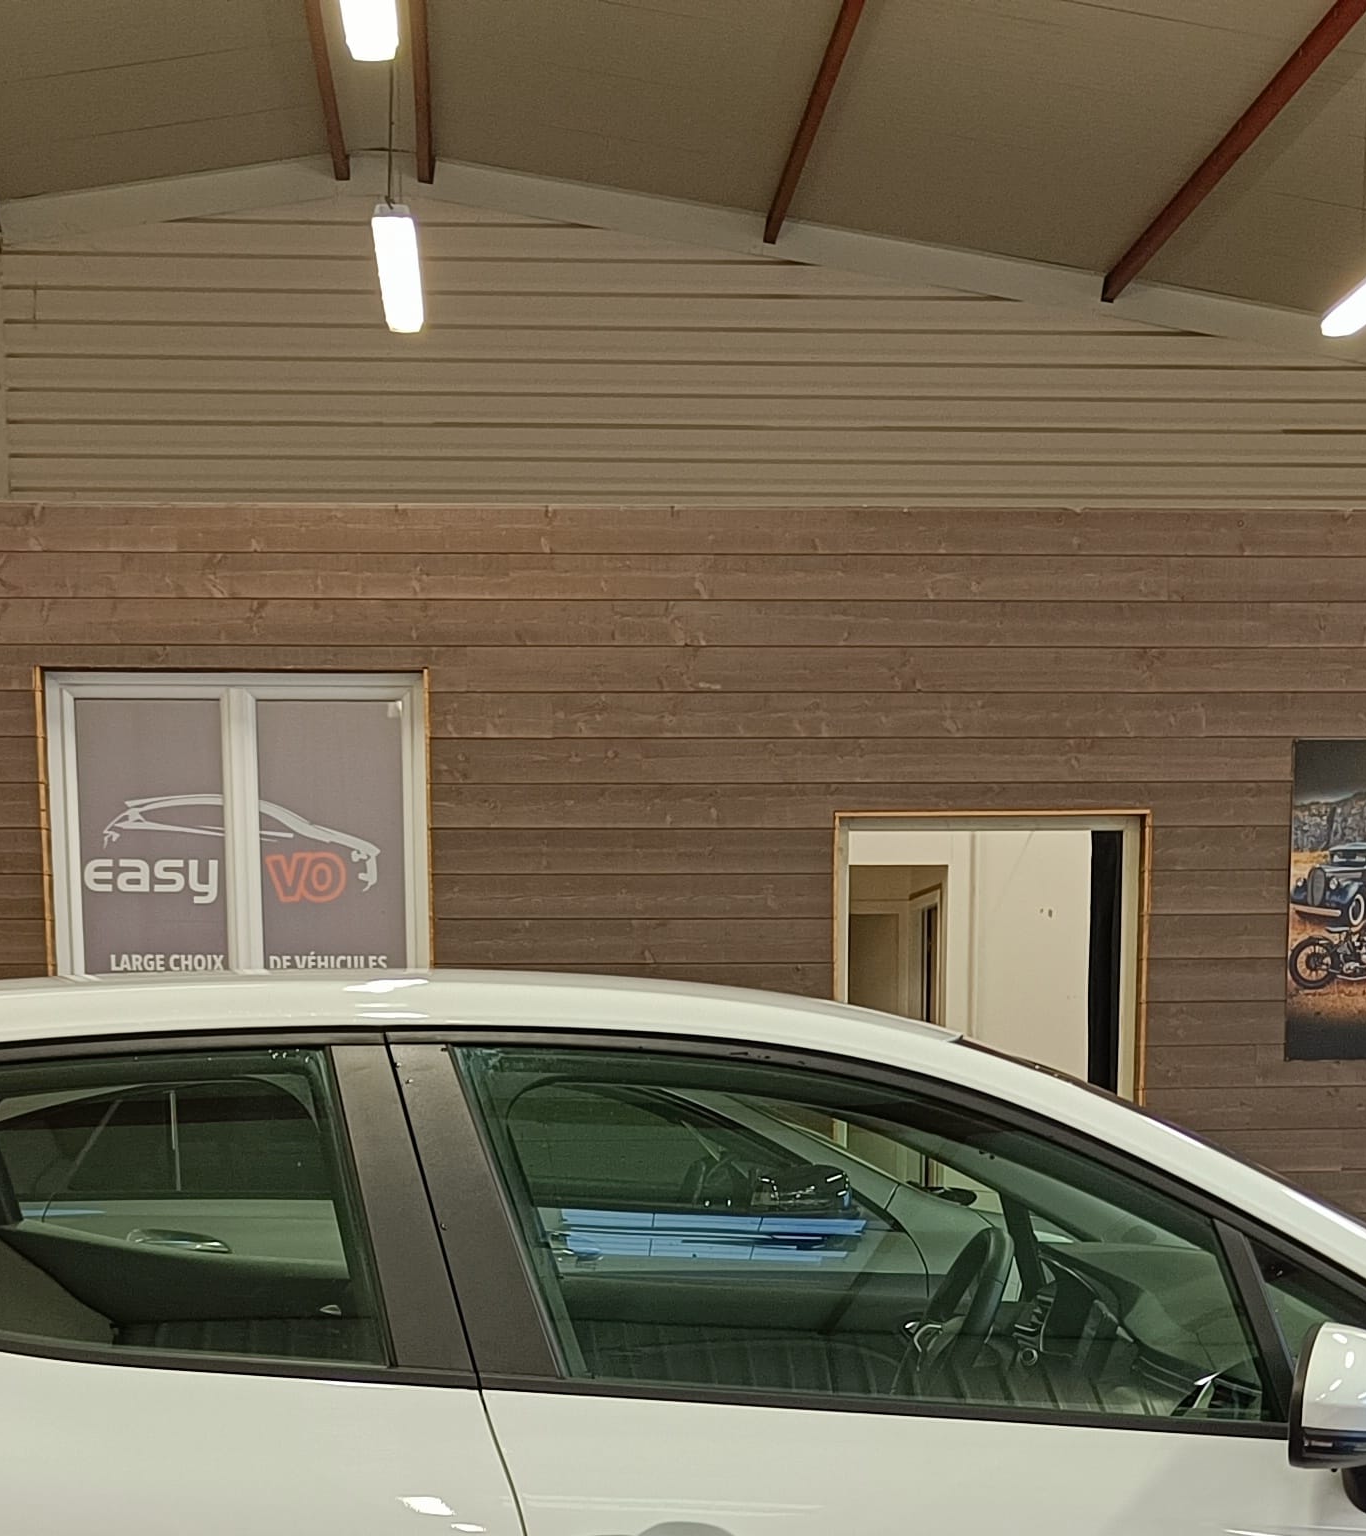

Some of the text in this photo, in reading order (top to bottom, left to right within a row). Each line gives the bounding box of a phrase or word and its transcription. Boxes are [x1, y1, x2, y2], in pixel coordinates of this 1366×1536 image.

[84, 852, 347, 904] easy VO
[109, 954, 165, 971] LARGE
[169, 954, 225, 971] CHOIX
[269, 955, 295, 969] DE
